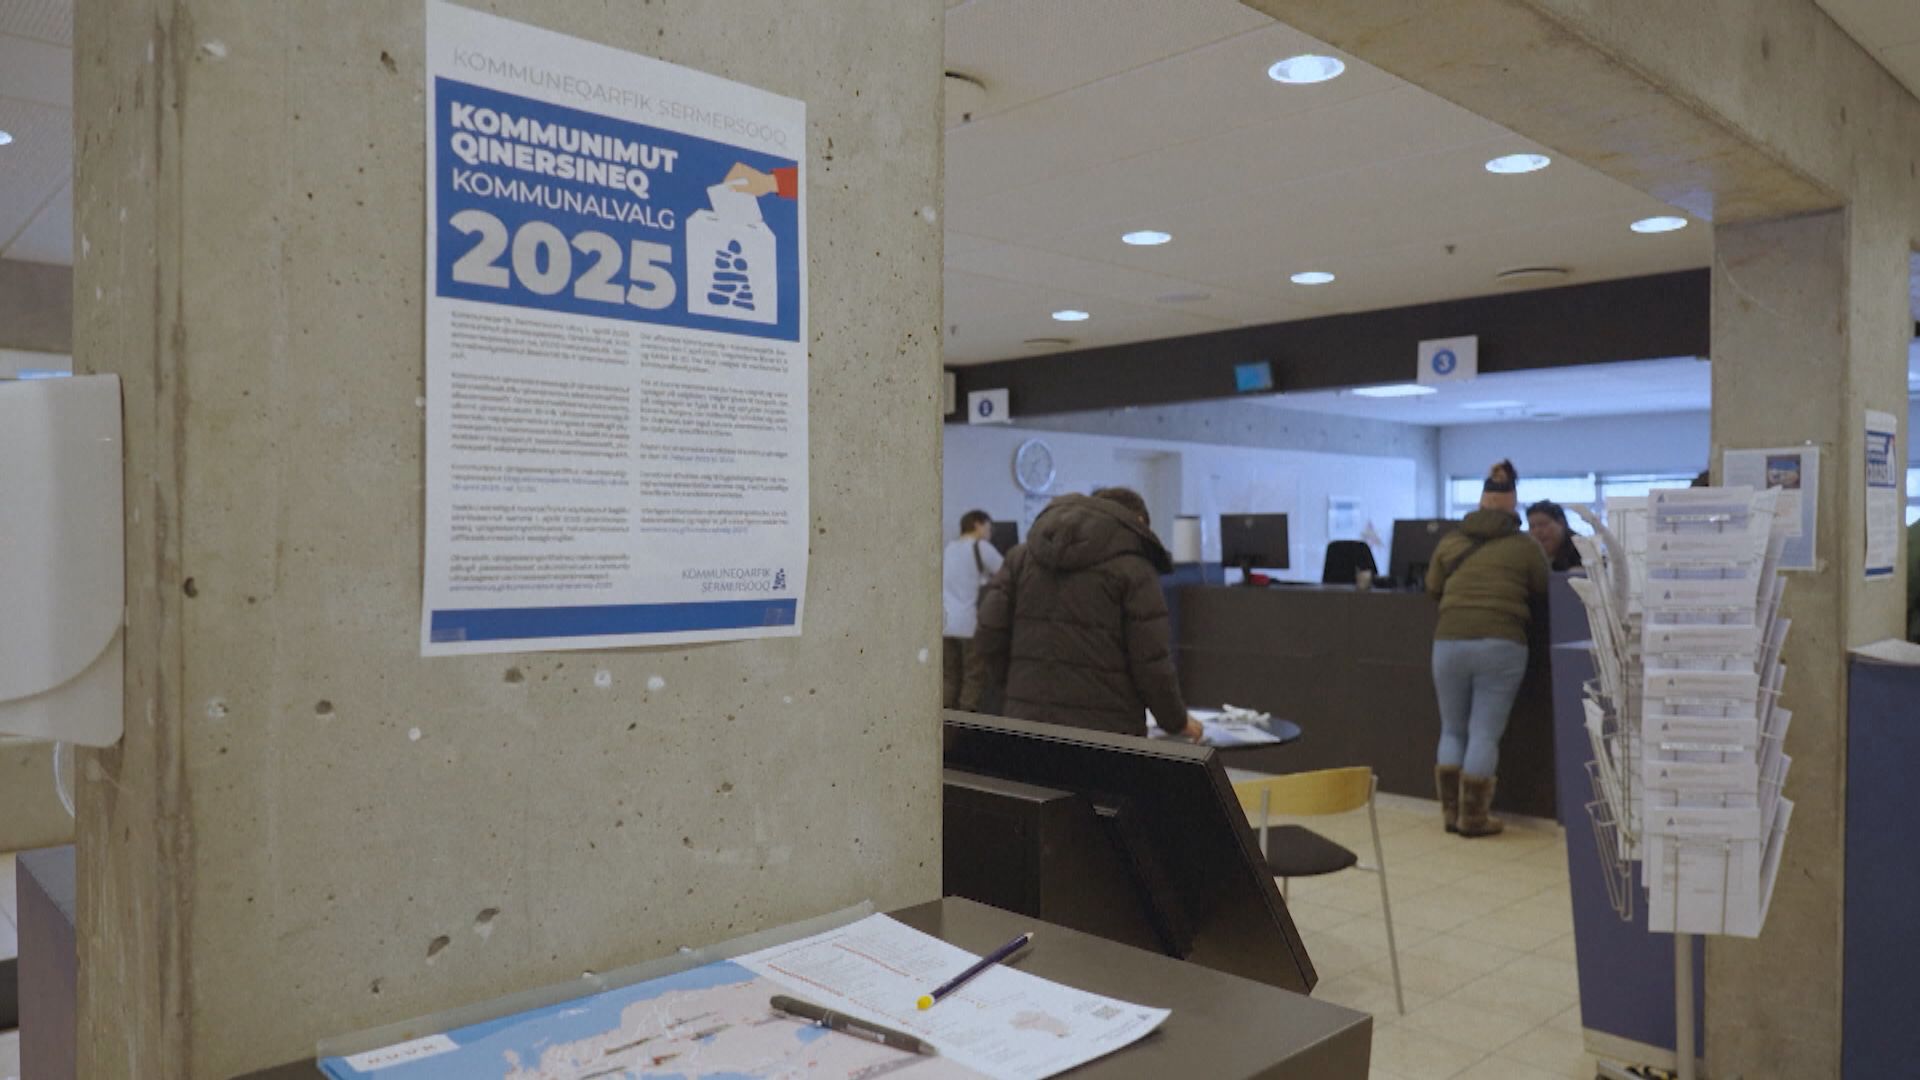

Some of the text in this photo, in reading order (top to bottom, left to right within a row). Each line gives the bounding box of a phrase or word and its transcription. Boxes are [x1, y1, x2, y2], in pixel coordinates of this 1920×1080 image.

[453, 48, 788, 147] KOMMUNEQARFIK SERMERSOOQ
[451, 102, 678, 173] KOMMUNIMUT
[451, 134, 650, 199] QINERSINEQ
[452, 168, 675, 230] KOMMUNALVALG
[449, 209, 677, 310] 2025
[1439, 354, 1450, 371] 3
[682, 567, 771, 579] KOMMUNEQARFIK
